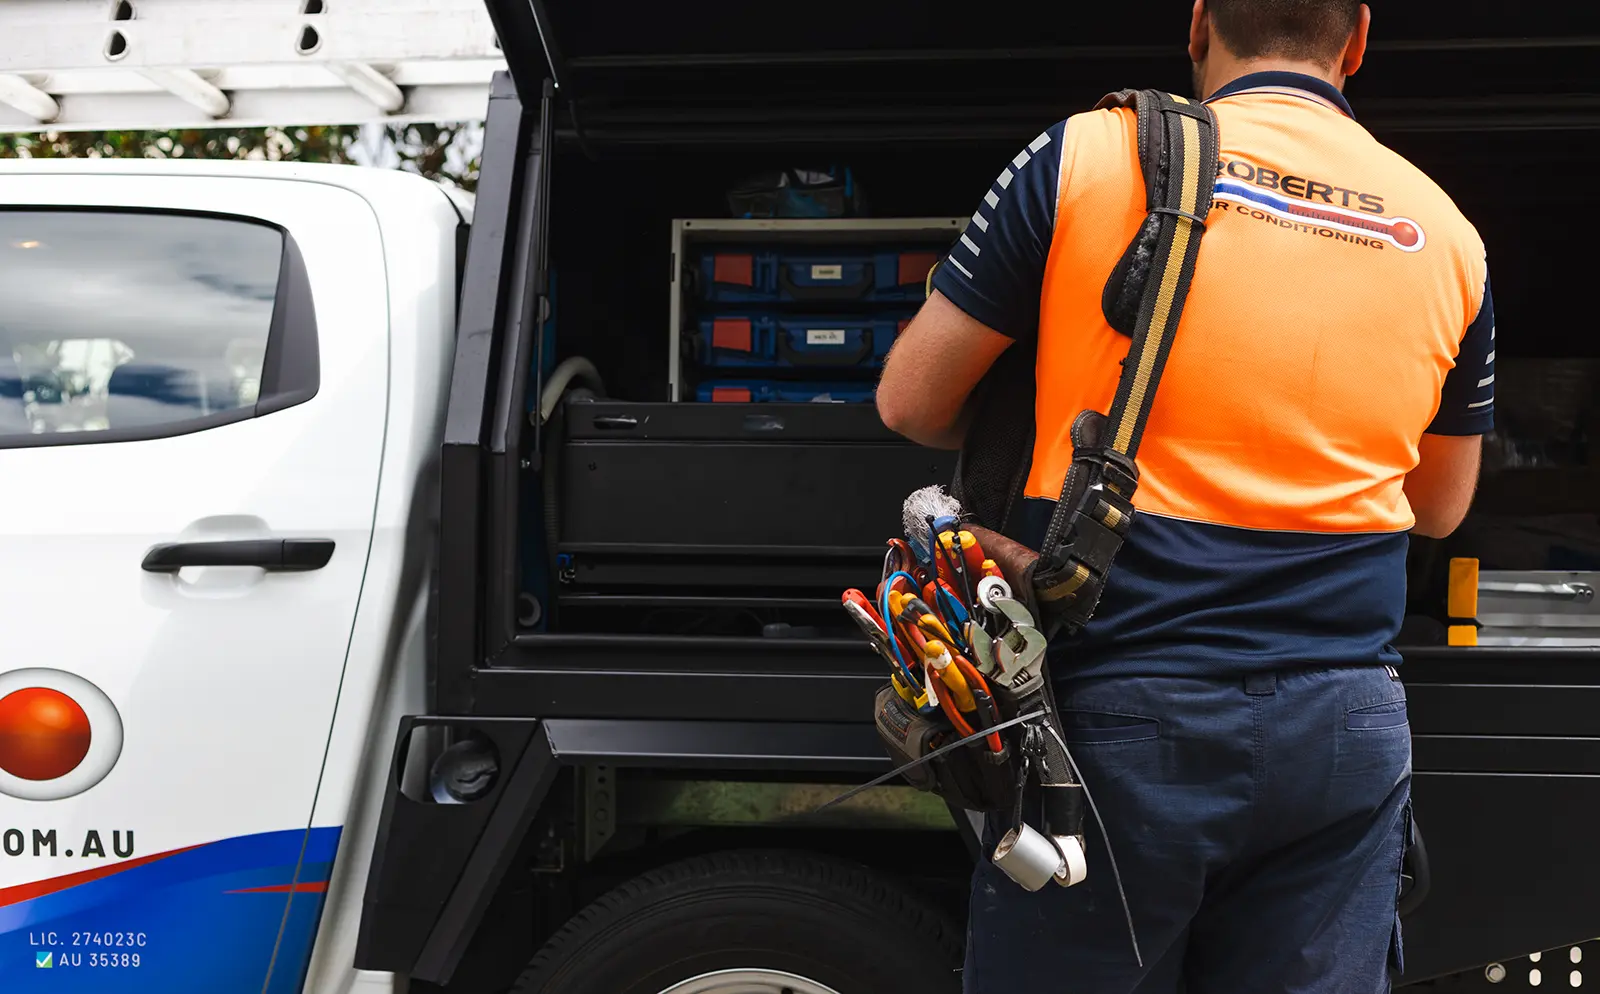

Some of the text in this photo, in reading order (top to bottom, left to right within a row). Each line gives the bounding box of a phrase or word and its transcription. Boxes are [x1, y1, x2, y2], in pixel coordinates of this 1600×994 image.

[1210, 200, 1384, 250] IR CONDITIONING
[3, 828, 135, 858] OM.AU
[29, 932, 147, 947] LIC. 274023C
[59, 953, 141, 968] AU 35389
